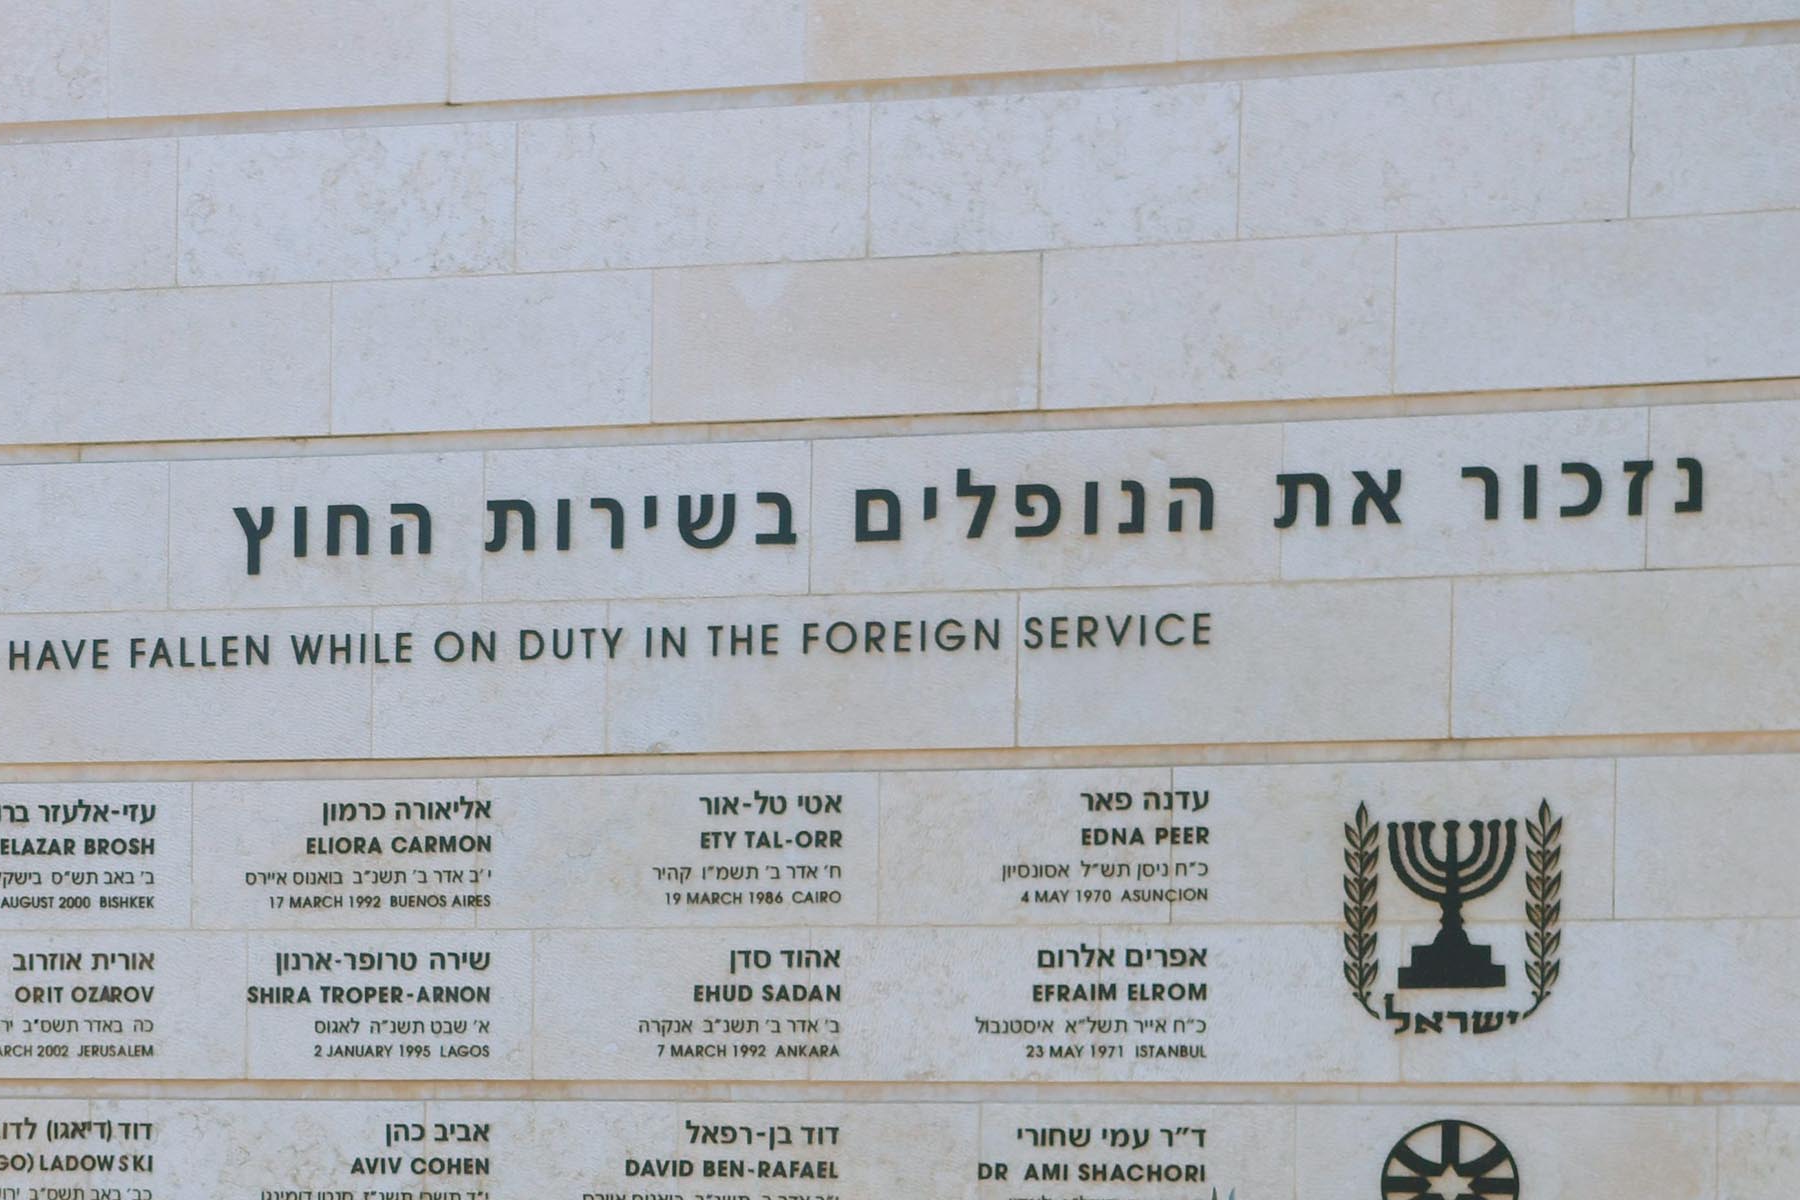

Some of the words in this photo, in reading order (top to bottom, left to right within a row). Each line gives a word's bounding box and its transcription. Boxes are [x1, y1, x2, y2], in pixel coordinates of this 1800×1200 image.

[1273, 468, 1402, 530] את
[1461, 456, 1704, 521] נזכור
[854, 468, 1215, 543] הנופלים
[484, 491, 797, 553] בשירות
[232, 502, 432, 576] החוץ
[8, 638, 109, 671] HAVE
[130, 634, 270, 669] FALLEN
[290, 632, 413, 666] WHILE
[433, 630, 496, 663] ON
[519, 627, 623, 661] DUTY
[645, 626, 686, 659] IN
[707, 623, 779, 657] THE
[802, 618, 1000, 655] FOREIGN
[1023, 612, 1211, 650] SERVICE
[394, 795, 492, 821] אליאורה
[797, 794, 843, 816] אטי
[1079, 791, 1134, 813] פאר
[1142, 789, 1210, 813] עדנה
[322, 802, 387, 827] כרמון
[306, 836, 384, 856] ELIORA
[390, 834, 492, 855] CARMON
[699, 830, 738, 850] ETY
[743, 829, 844, 850] TAL-ORR
[1080, 826, 1146, 847] EDNA
[1154, 824, 1210, 847] PEER
[83, 837, 156, 857] BROSH
[0, 895, 55, 910] AUGUST
[58, 895, 92, 910] 2000
[98, 895, 155, 910] BISHKEK
[1020, 890, 1030, 904] 4
[1034, 888, 1070, 904] MAY
[1076, 888, 1112, 904] 1970
[1120, 887, 1209, 902] ASUNCION
[12, 952, 83, 972] אוזרוב
[90, 952, 155, 972] אורית
[429, 951, 492, 972] שירה
[729, 949, 772, 975] סדן
[779, 948, 841, 969] אהוד
[1036, 942, 1116, 969] אלרום
[1124, 947, 1208, 969] אפרים
[14, 985, 65, 1005] ORIT
[70, 984, 156, 1004] OZAROV
[246, 985, 313, 1005] SHIRA
[319, 985, 492, 1005] TROPER-ARNON
[693, 983, 754, 1004] EHUD
[761, 983, 842, 1003] SADAN
[1031, 982, 1117, 1004] EFRAIM
[1127, 982, 1208, 1003] ELROM
[1383, 993, 1520, 1035] ישראל
[313, 1044, 323, 1058] 2
[326, 1044, 394, 1058] JANUARY
[399, 1043, 432, 1059] 1995
[439, 1044, 491, 1059] LAGOS
[1025, 1044, 1045, 1059] 23
[1049, 1044, 1085, 1059] MAY
[1090, 1043, 1124, 1059] 1971
[1135, 1043, 1208, 1060] ISTANBUL
[117, 1122, 154, 1141] דוד
[385, 1123, 427, 1148] כהן
[433, 1123, 491, 1143] אביב
[799, 1125, 840, 1146] דוד
[1016, 1127, 1092, 1149] שחורי
[1101, 1127, 1151, 1151] עמי
[349, 1156, 403, 1176] AVIV
[410, 1156, 491, 1176] COHEN
[624, 1157, 695, 1178] DAVID
[702, 1159, 840, 1180] BEN-RAFAEL
[977, 1161, 1009, 1182] DR
[1023, 1162, 1069, 1182] AMI
[1077, 1162, 1206, 1184] SHACHORI
